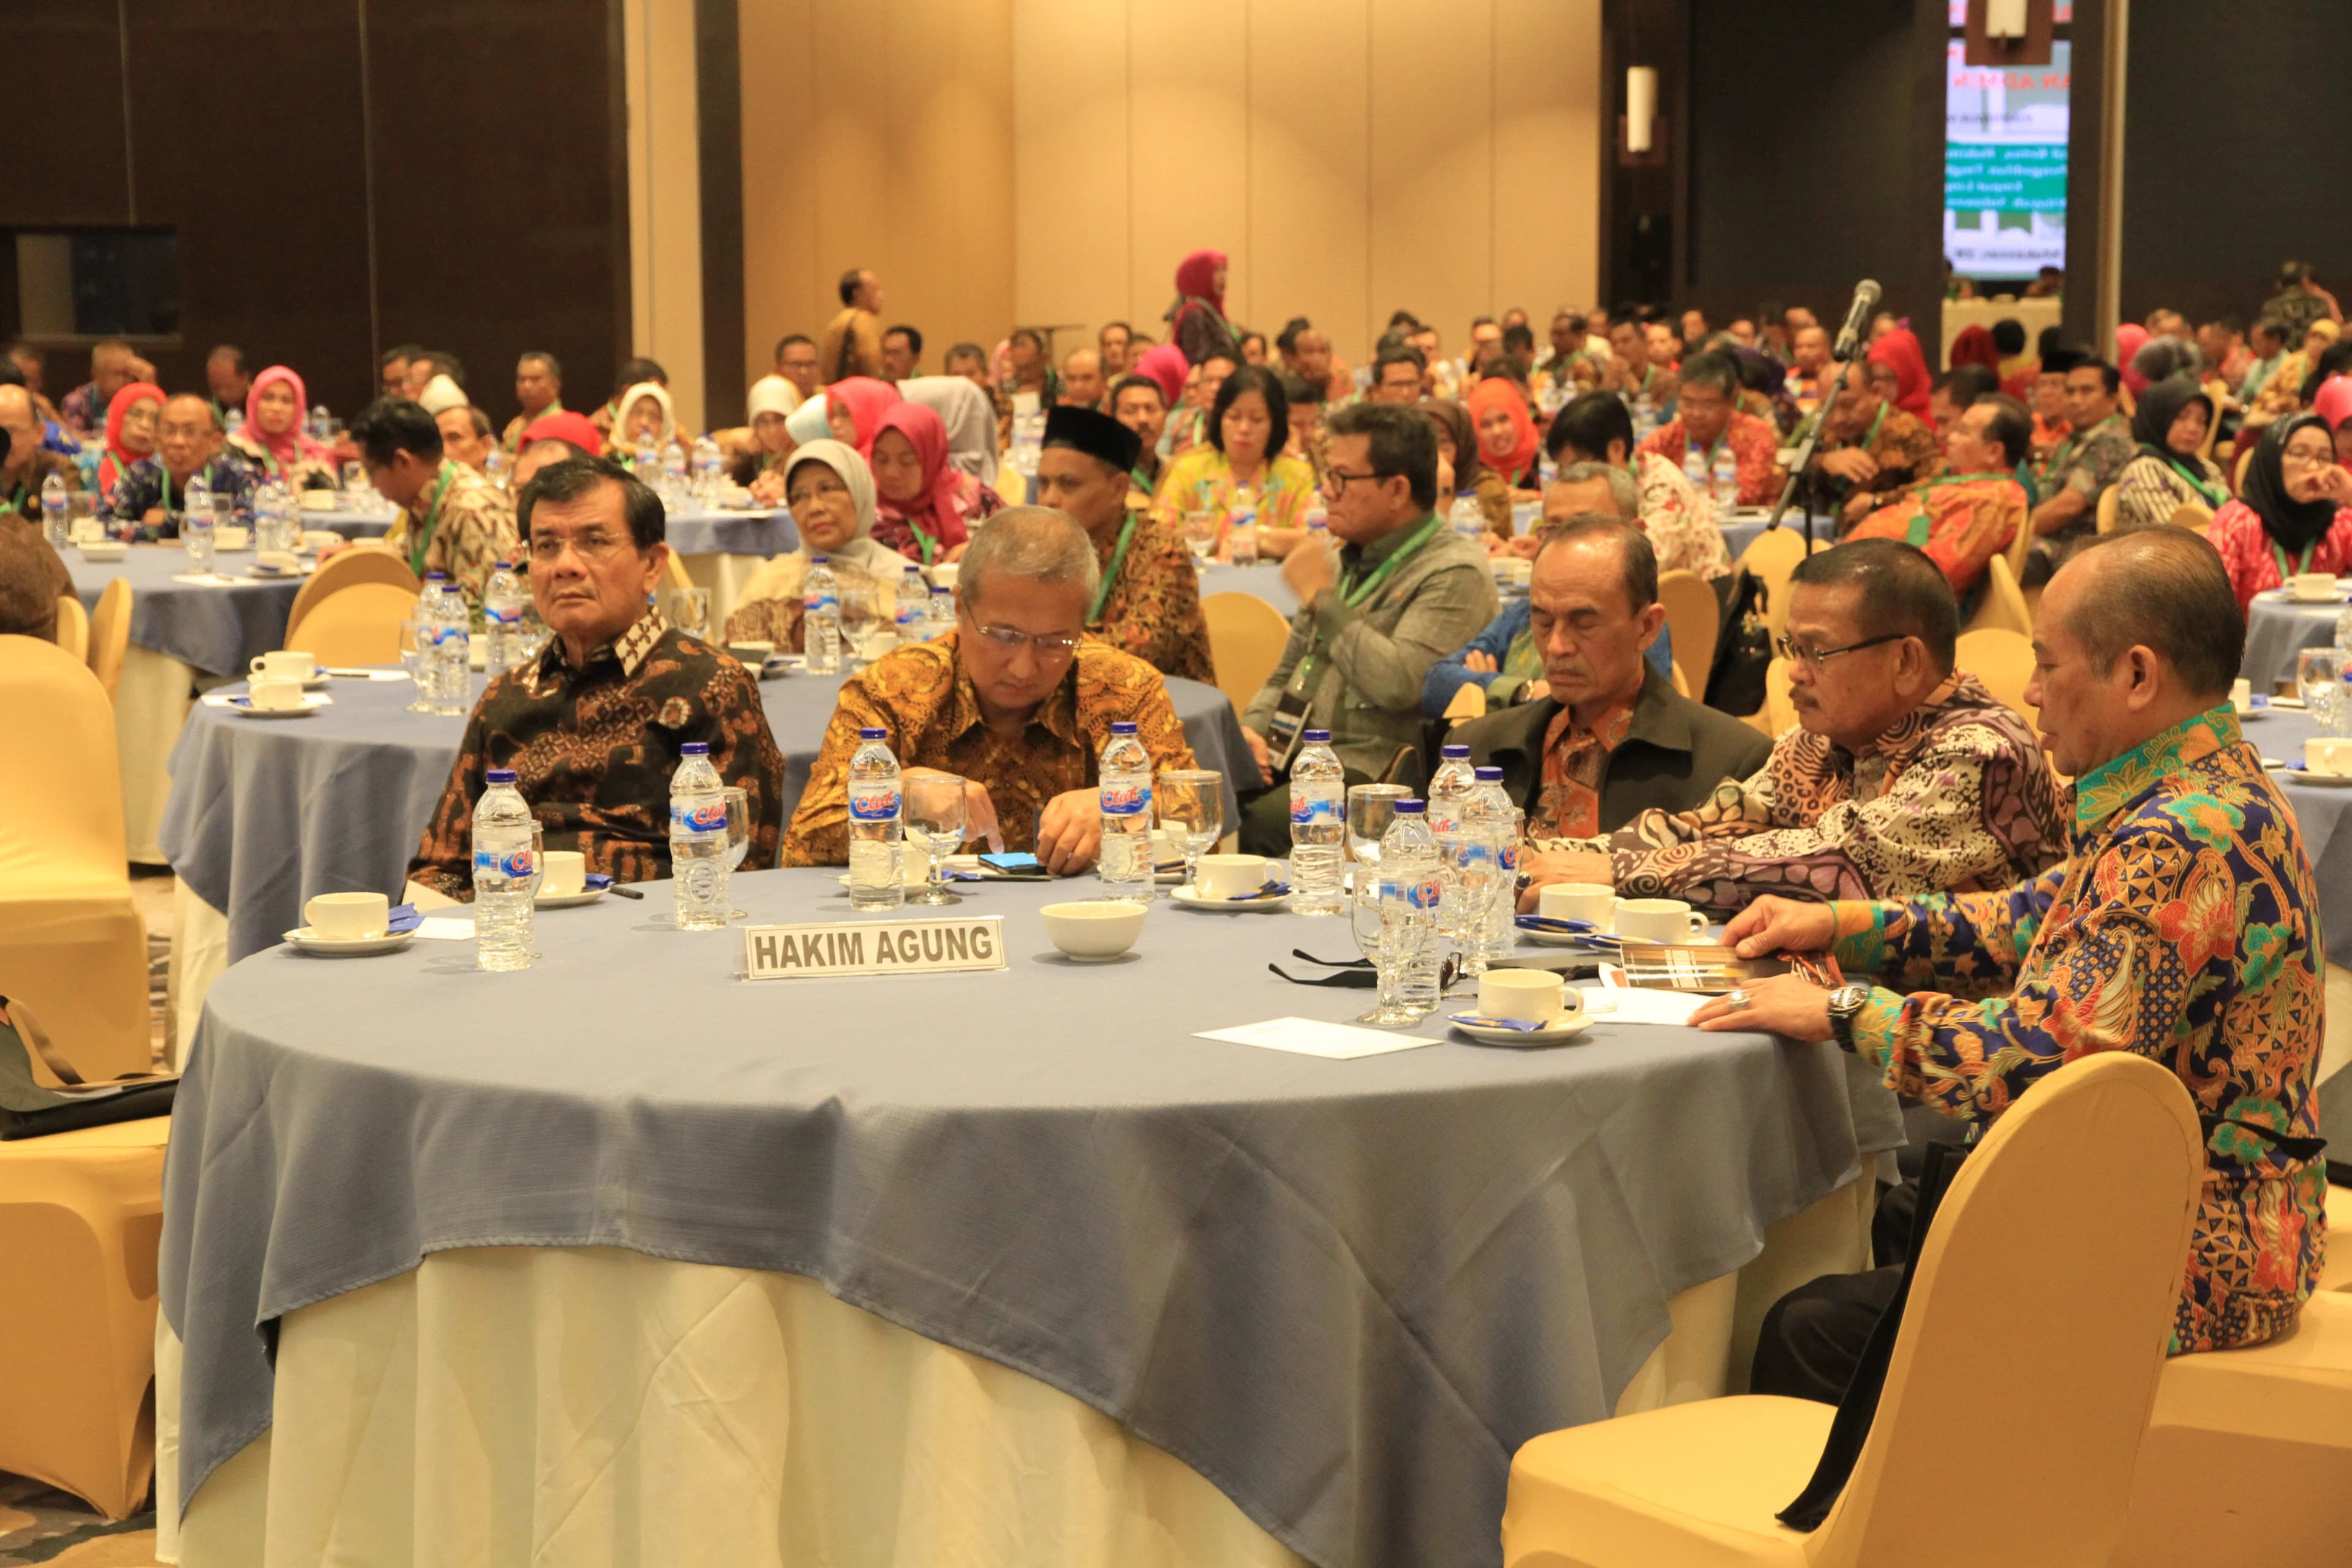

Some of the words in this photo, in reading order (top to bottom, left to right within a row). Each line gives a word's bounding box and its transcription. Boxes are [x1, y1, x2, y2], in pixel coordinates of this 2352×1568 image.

[856, 790, 893, 813] Club
[1103, 785, 1137, 807] Club
[755, 932, 865, 970] HAKIM
[875, 926, 993, 964] AGUNG
